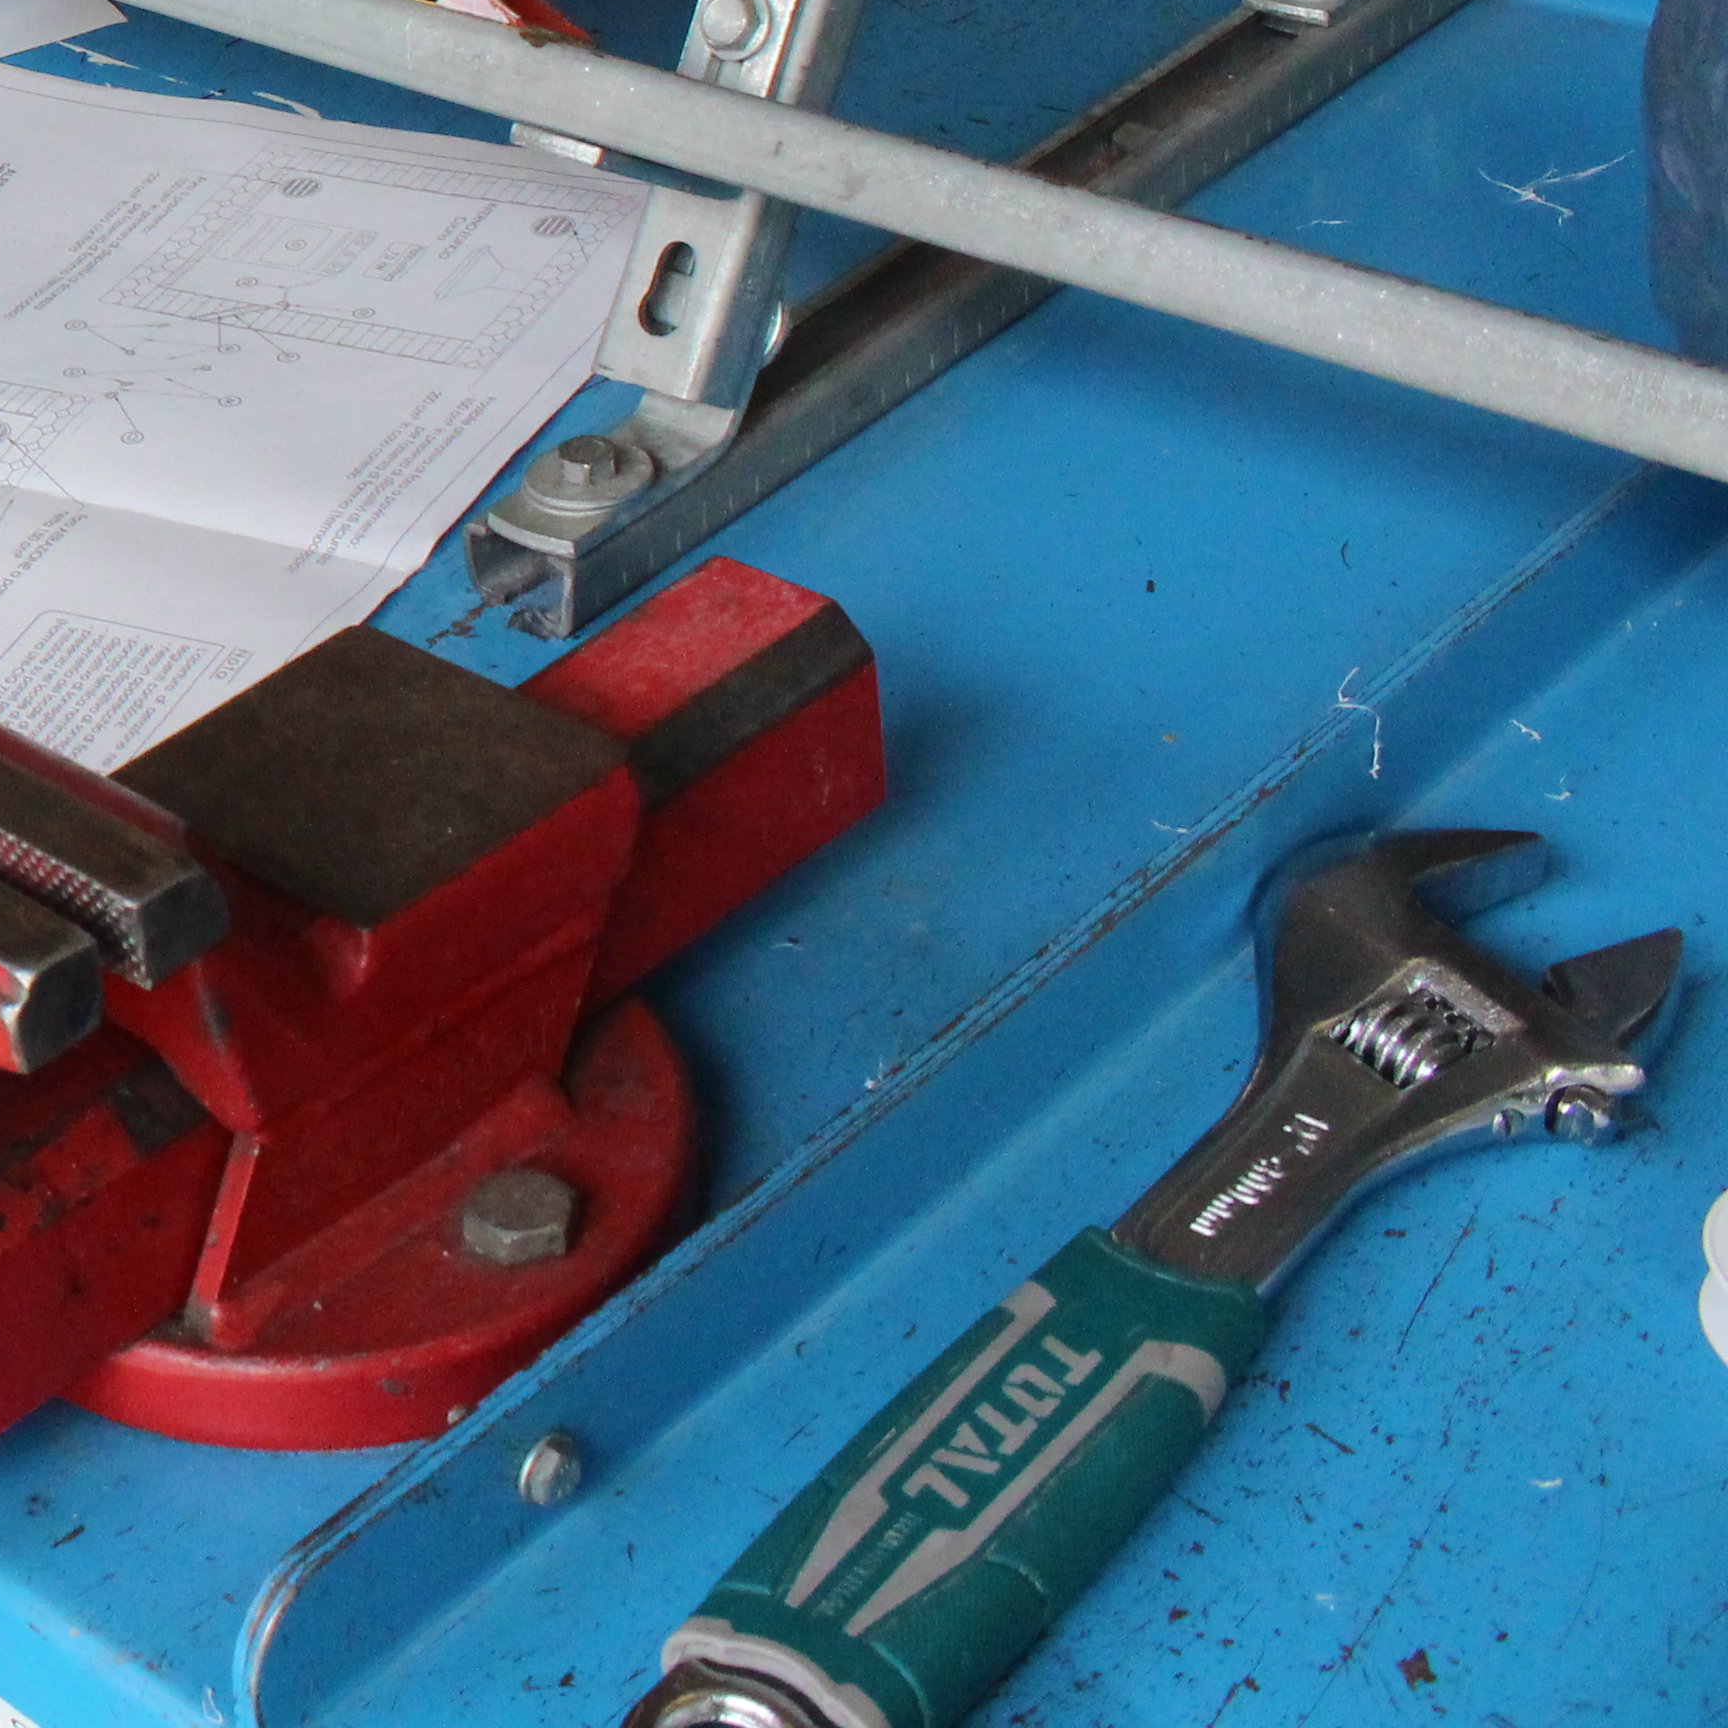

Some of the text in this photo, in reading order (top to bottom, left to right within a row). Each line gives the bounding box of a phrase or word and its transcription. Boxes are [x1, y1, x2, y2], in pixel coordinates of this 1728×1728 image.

[395, 434, 439, 469] presenza
[336, 496, 403, 549] pavimento:
[28, 617, 71, 650] (Norma
[36, 627, 81, 665] installate
[48, 629, 95, 668] presenza
[59, 632, 112, 678] volumetria
[74, 637, 127, 681] dispositivo
[99, 639, 141, 672] portata
[123, 643, 156, 669] senza
[137, 646, 174, 675] nessun
[160, 647, 211, 691] L'apertura
[211, 648, 252, 680] Nota
[2, 675, 38, 703] pareti
[38, 668, 62, 683] nel
[48, 678, 69, 693] del
[71, 673, 112, 707] termica
[84, 669, 139, 714] dispositivo
[110, 644, 191, 729] seguenti condizioni:
[15, 683, 50, 710] locale
[24, 693, 57, 719] locale
[85, 676, 151, 733] apparecchio
[111, 707, 161, 750] aerazione
[902, 1336, 1102, 1508] TOTAL
